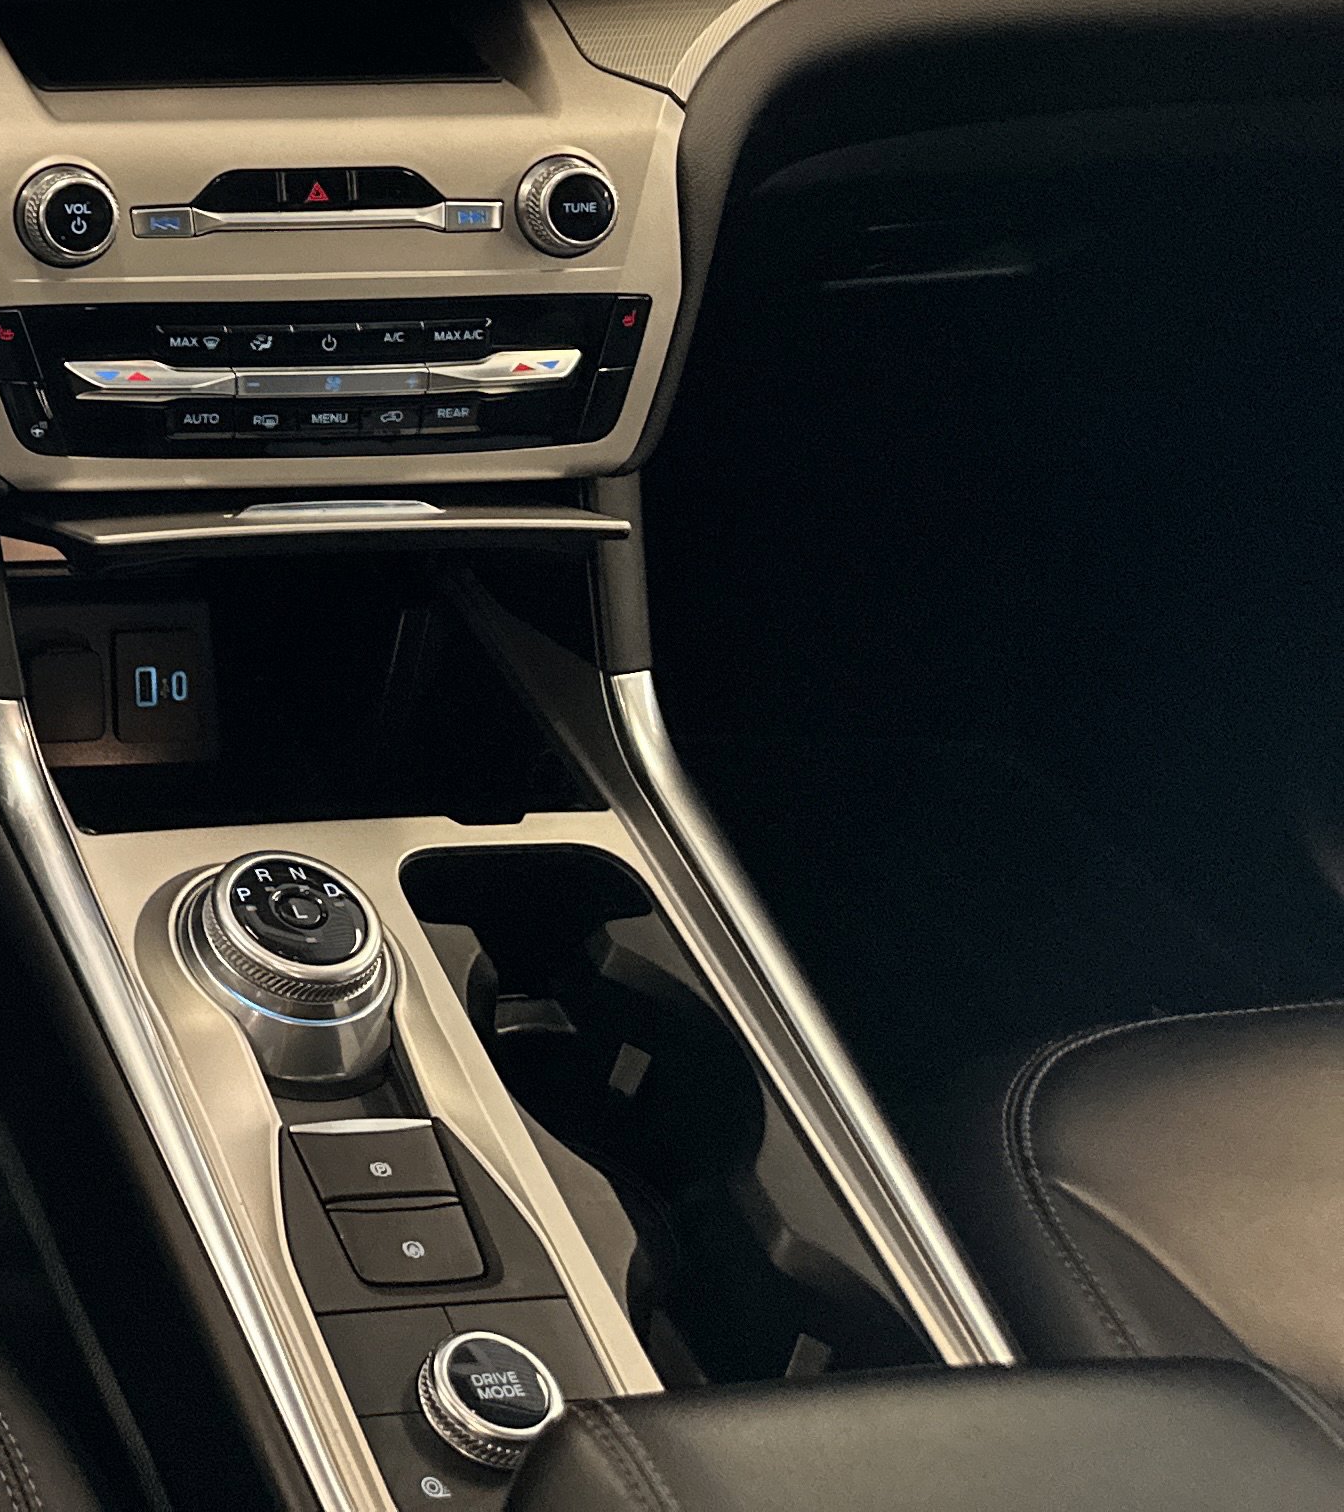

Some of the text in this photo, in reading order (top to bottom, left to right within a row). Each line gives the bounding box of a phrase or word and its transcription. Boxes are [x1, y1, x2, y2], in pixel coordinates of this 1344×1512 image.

[64, 203, 92, 215] VOL
[563, 202, 597, 213] TUNE
[384, 332, 404, 343] A/C
[434, 329, 483, 342] MAX A/C
[169, 337, 198, 348] MAX
[183, 413, 220, 425] AUTO
[311, 412, 348, 424] MENU
[437, 407, 469, 419] REAR
[236, 867, 343, 902] P R N D
[292, 904, 308, 919] L
[470, 1371, 519, 1386] DRIVE
[477, 1384, 526, 1400] MODE
